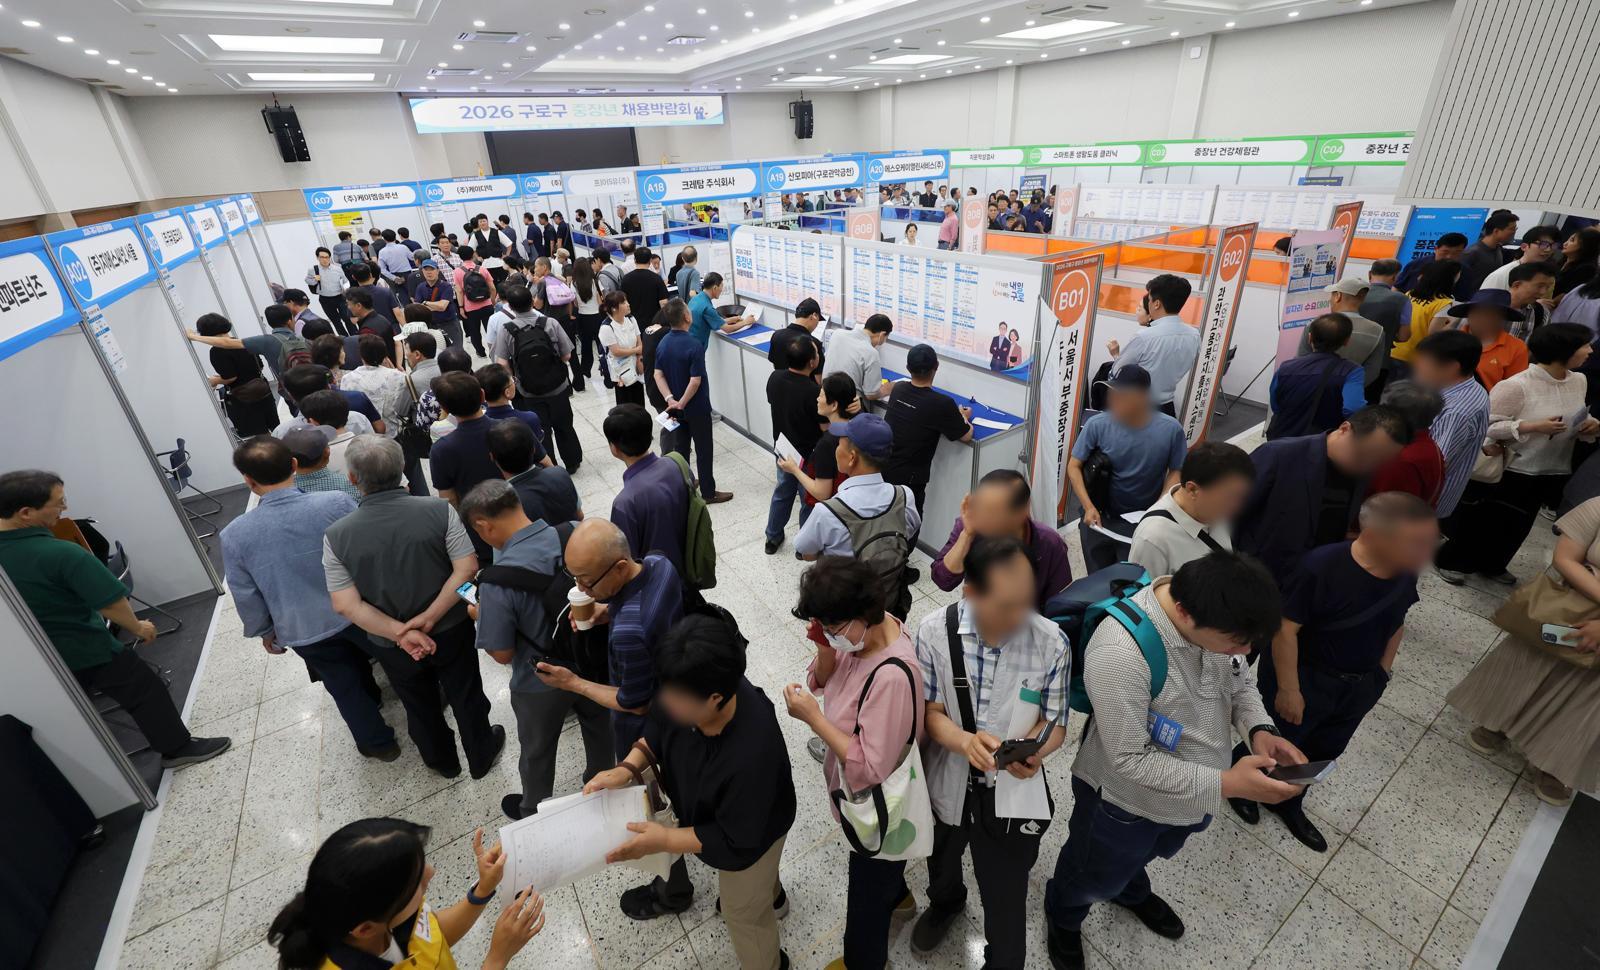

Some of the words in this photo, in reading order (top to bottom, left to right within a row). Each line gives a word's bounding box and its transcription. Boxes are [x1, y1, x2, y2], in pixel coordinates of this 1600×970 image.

[458, 105, 514, 119] 2026
[518, 104, 568, 118] 구로구
[572, 103, 618, 117] 중장년
[621, 102, 692, 116] 채용박람회
[1053, 151, 1075, 159] 스마트폰
[1076, 150, 1098, 158] 생활도움
[1099, 149, 1118, 158] 클리닉
[1194, 147, 1217, 157] 중장년
[1219, 146, 1260, 156] 건강체험관
[1322, 144, 1344, 154] C04
[1366, 143, 1399, 155] 중장년
[788, 167, 855, 182] 산모피아(구로관악금천)
[869, 166, 883, 174] A20
[706, 177, 736, 189] 주식회사
[770, 173, 784, 183] A19
[428, 188, 445, 197] A08
[647, 182, 665, 193] A18
[314, 196, 331, 206] A07
[735, 255, 753, 270] 중장년
[1222, 249, 1243, 268] B02
[66, 260, 88, 285] A02
[1059, 287, 1084, 311] B01
